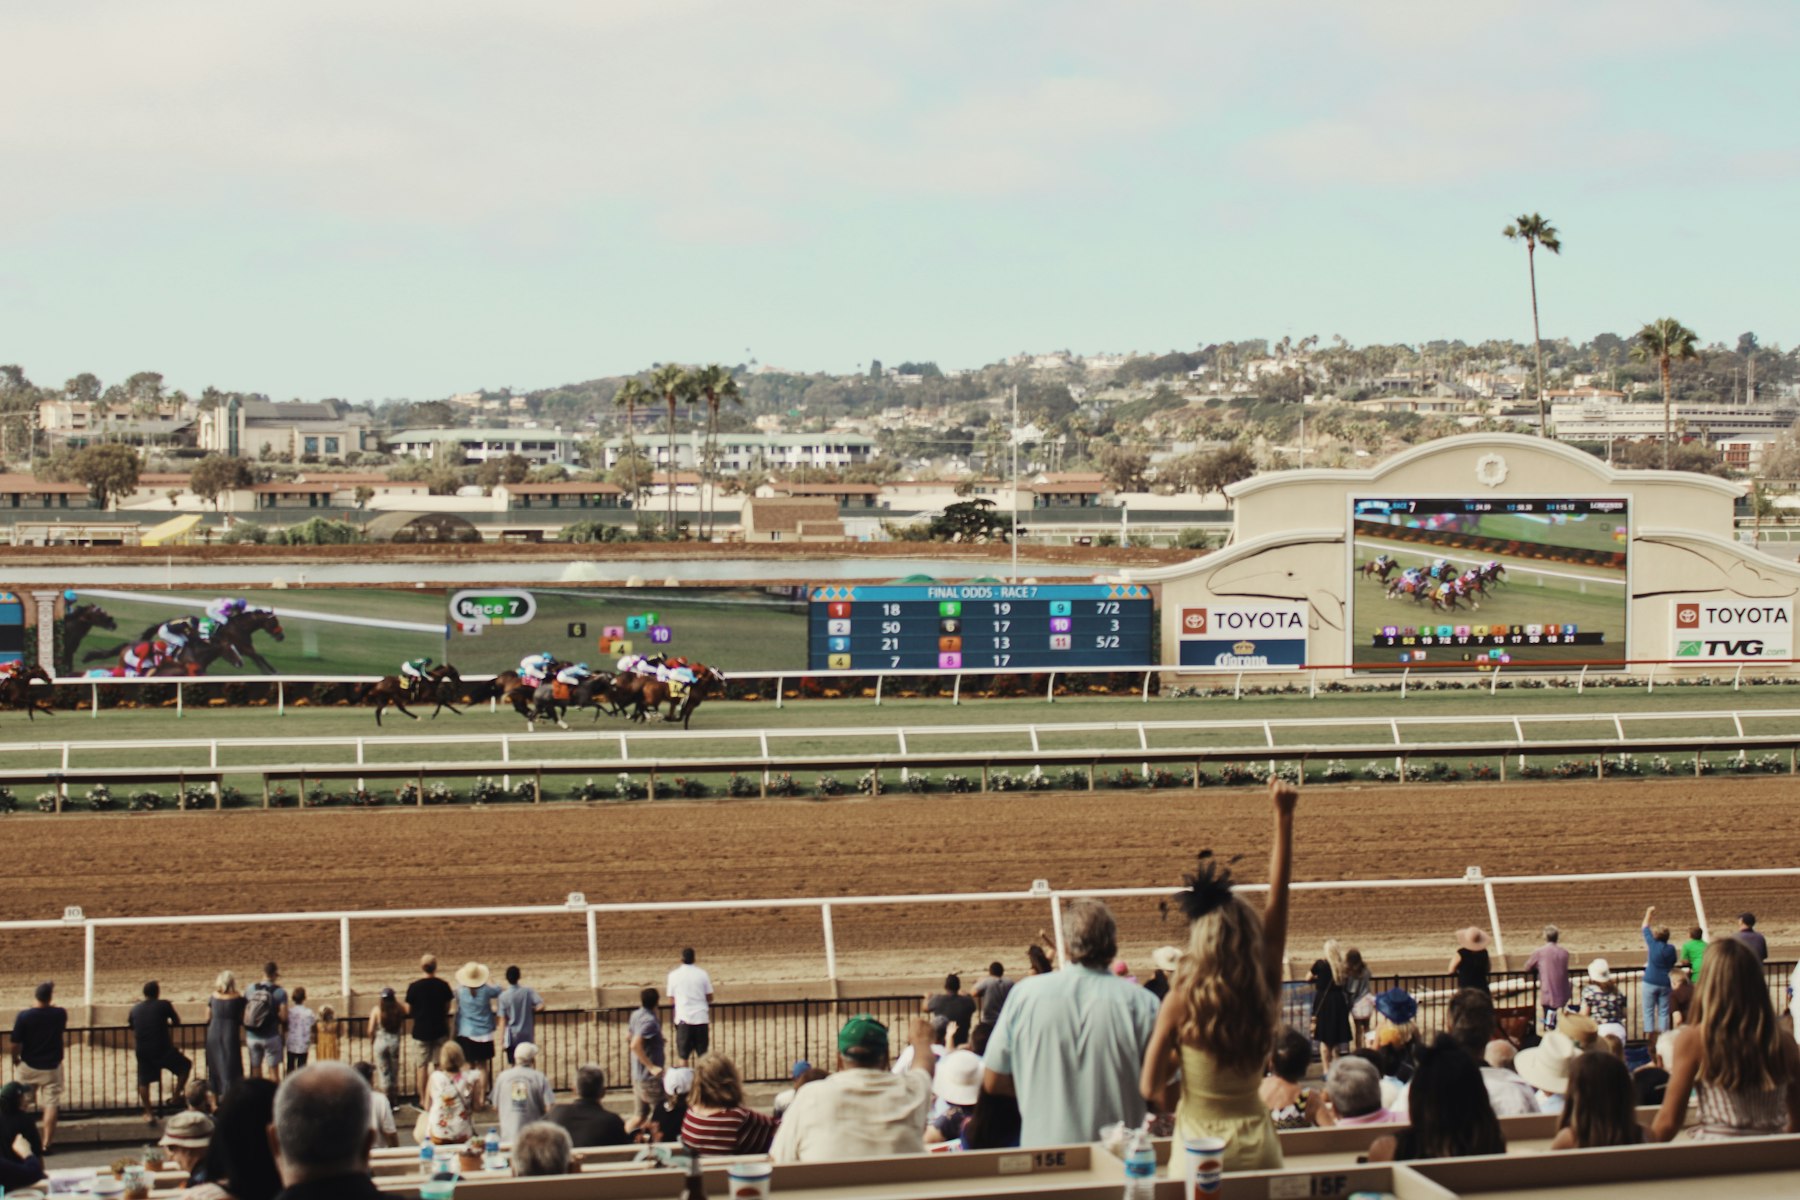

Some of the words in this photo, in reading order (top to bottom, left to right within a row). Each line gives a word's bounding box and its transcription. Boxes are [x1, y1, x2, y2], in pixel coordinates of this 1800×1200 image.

[1409, 502, 1416, 513] 7
[928, 587, 959, 598] FINAL
[961, 587, 993, 598] ODDS
[1000, 587, 1027, 598] RACE
[1028, 587, 1037, 598] 7
[460, 601, 504, 615] Race
[508, 601, 519, 614] 7
[836, 604, 843, 615] 1
[882, 604, 901, 616] 18
[946, 604, 955, 615] 5
[993, 603, 1011, 615] 19
[1057, 604, 1065, 613] 9
[1096, 602, 1120, 615] 7/2
[1215, 612, 1302, 628] TOYOTA
[1706, 608, 1787, 623] TOYOTA
[573, 624, 582, 636] 6
[836, 622, 844, 633] 2
[881, 622, 901, 634] 50
[946, 621, 955, 633] 6
[993, 621, 1011, 632] 17
[1053, 620, 1068, 631] 10
[1110, 620, 1120, 632] 3
[1385, 627, 1396, 636] 10
[1567, 625, 1574, 634] 3
[654, 629, 669, 642] 10
[1387, 637, 1394, 645] 3
[1421, 636, 1433, 645] 19
[1458, 636, 1469, 644] 17
[1478, 636, 1484, 644] 7
[1493, 636, 1504, 644] 13
[1511, 635, 1522, 644] 17
[1564, 635, 1574, 643] 21
[836, 638, 844, 650] 3
[881, 638, 900, 650] 21
[946, 639, 954, 650] 7
[993, 637, 1011, 649] 13
[1055, 637, 1068, 648] 11
[1096, 636, 1120, 648] 5/2
[836, 656, 844, 667] 4
[890, 656, 900, 668] 7
[946, 656, 955, 667] 8
[993, 655, 1011, 667] 17
[1215, 653, 1268, 665] Corona
[67, 909, 80, 917] 10
[1036, 1152, 1066, 1167] 15E
